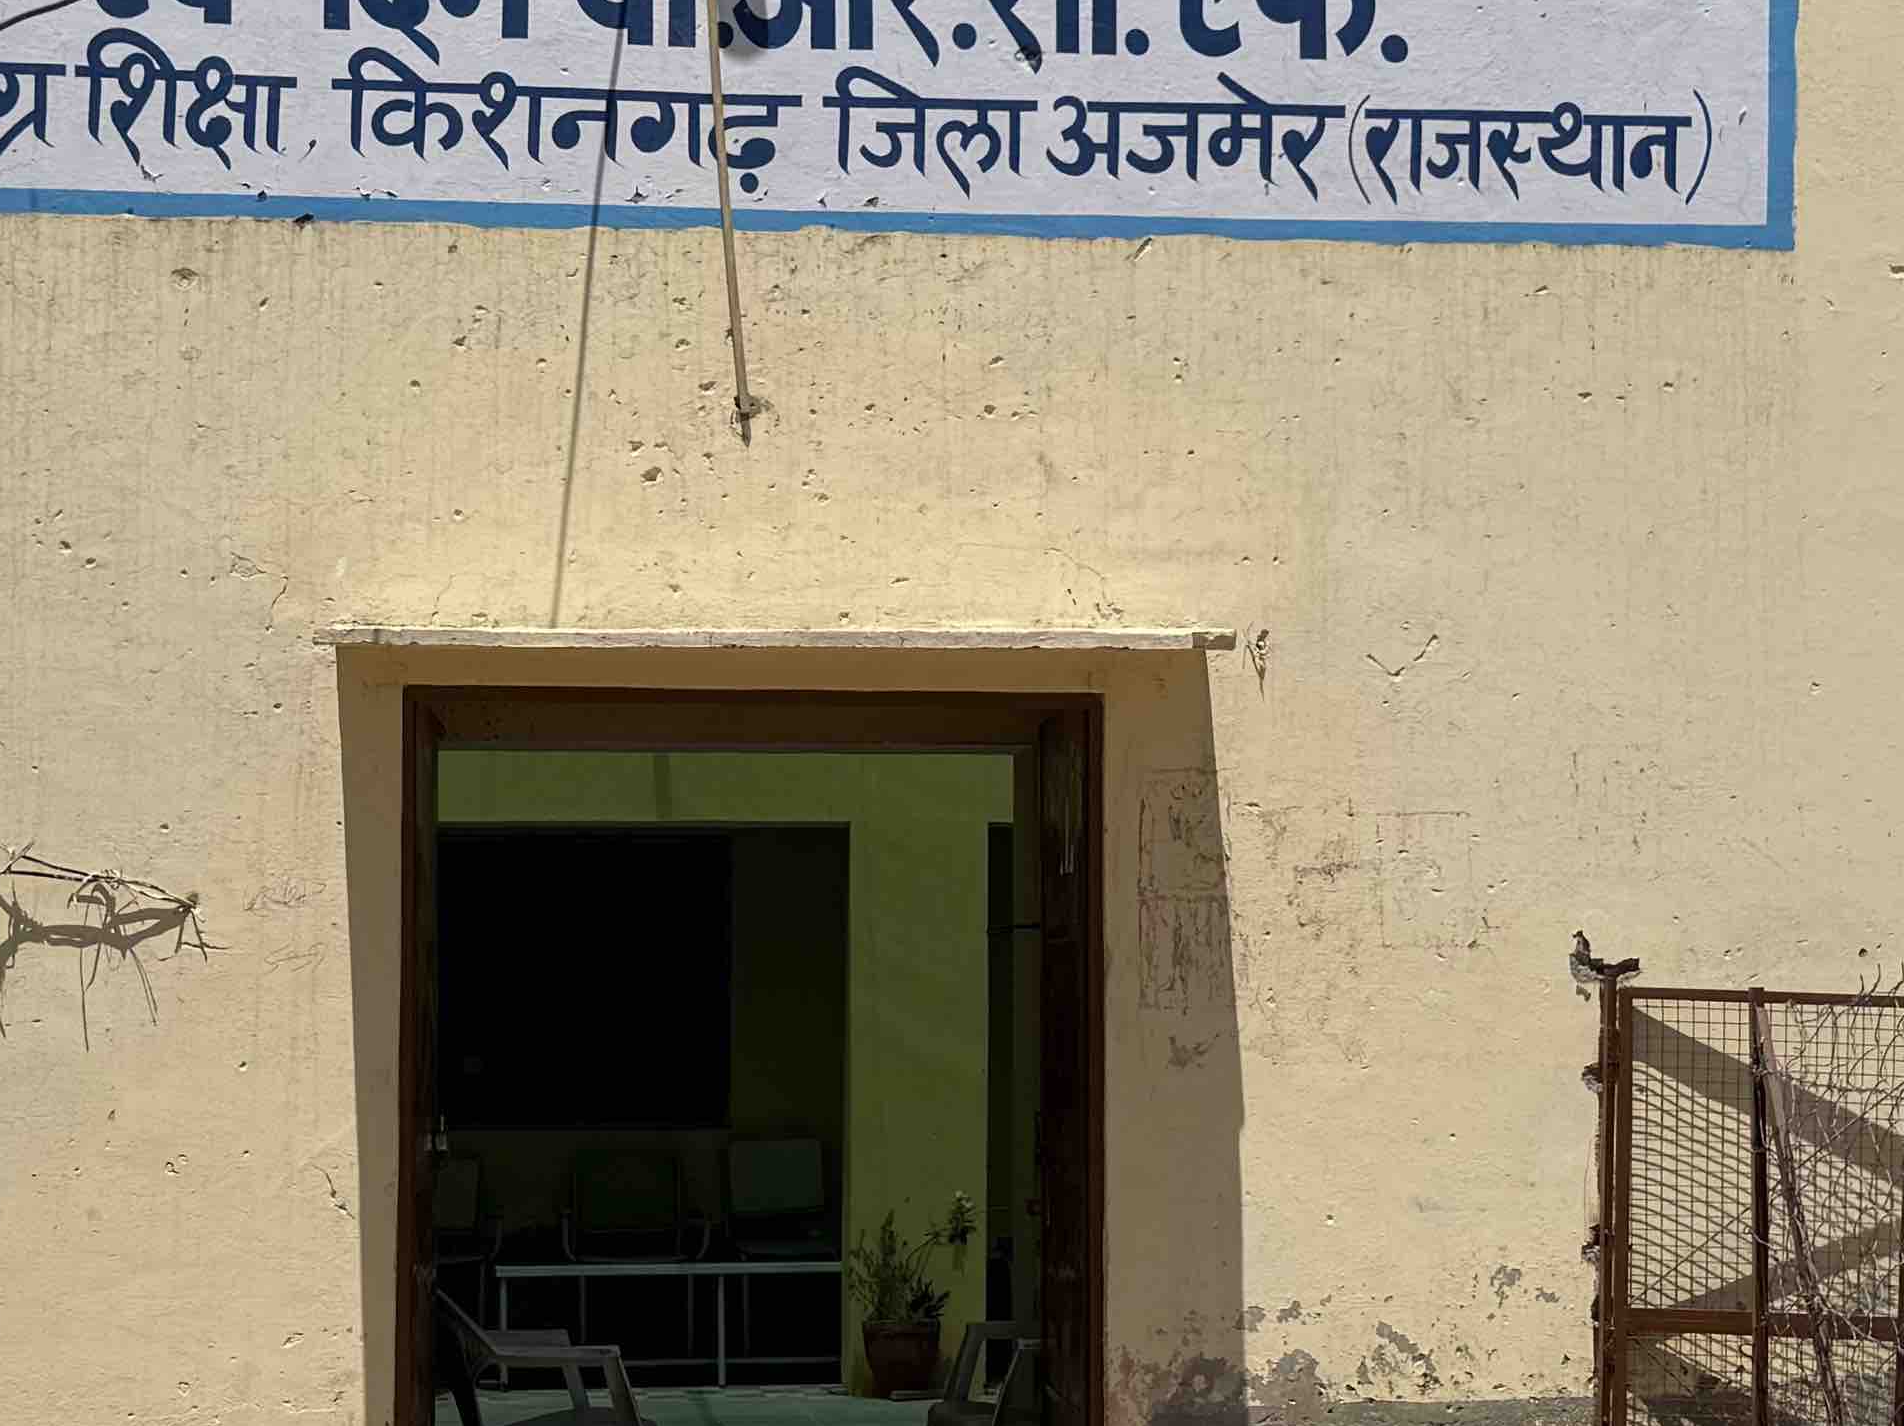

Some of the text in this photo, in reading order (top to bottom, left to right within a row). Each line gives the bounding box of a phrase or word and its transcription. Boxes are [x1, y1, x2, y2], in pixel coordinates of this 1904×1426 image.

[332, 46, 803, 194] किशनगढ़
[823, 65, 1038, 201] जिला
[1045, 71, 1347, 202] अजमेर
[1348, 88, 1713, 206] (राजस्थान)
